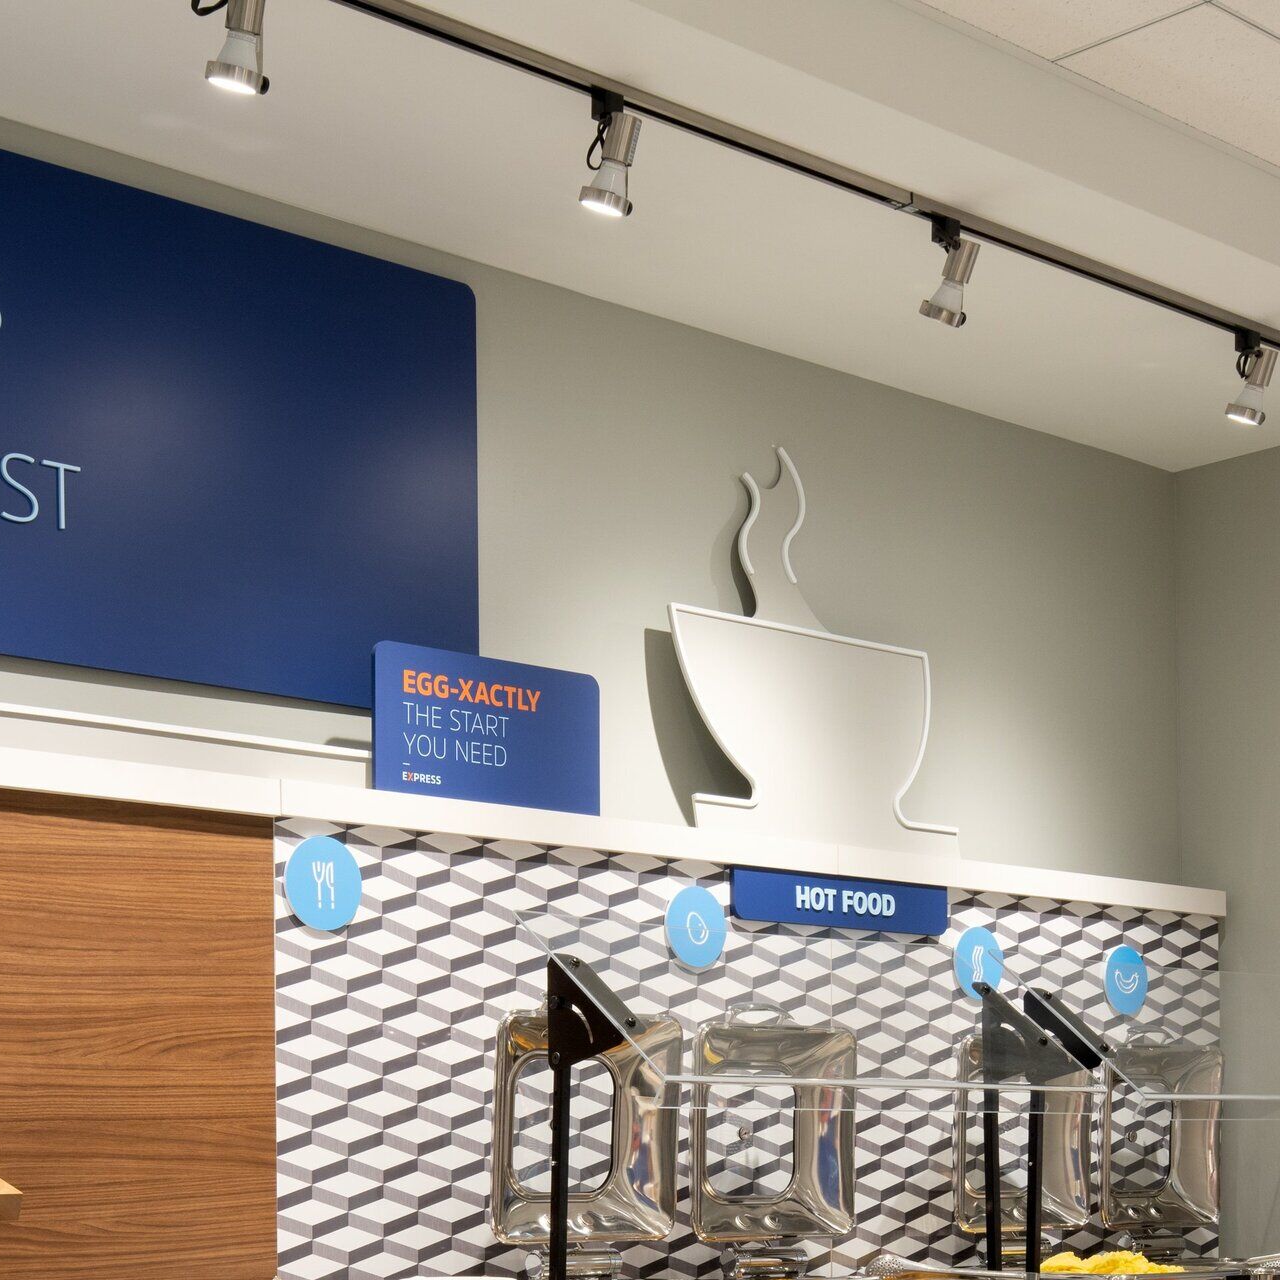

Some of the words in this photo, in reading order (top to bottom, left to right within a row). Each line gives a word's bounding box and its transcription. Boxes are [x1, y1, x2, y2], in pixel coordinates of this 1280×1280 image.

[402, 669, 541, 712] EGG-XACTLY
[402, 701, 443, 729] THE
[449, 708, 510, 738] START
[403, 732, 447, 760] YOU
[455, 740, 507, 767] NEED
[402, 771, 442, 785] EXPRESS
[795, 885, 837, 911] HOT
[842, 890, 896, 917] FOOD
